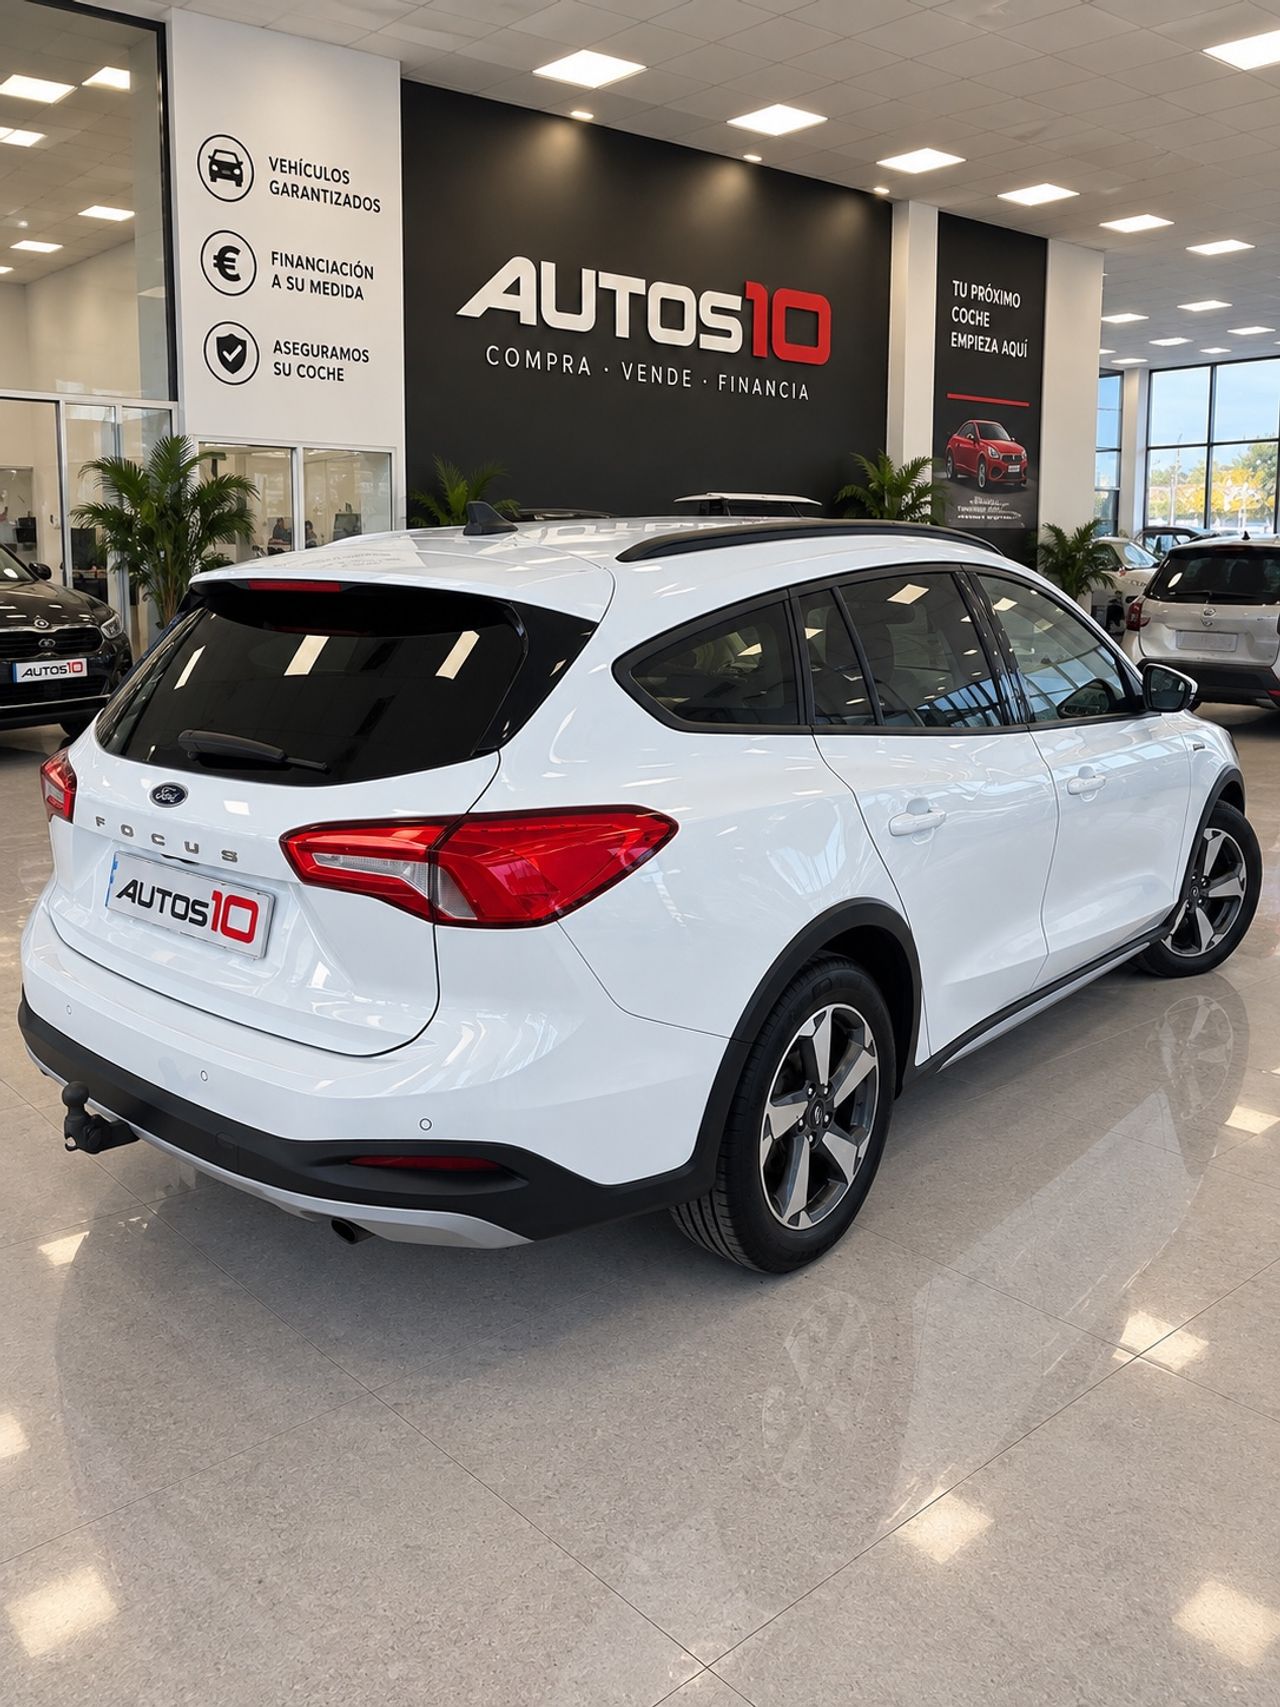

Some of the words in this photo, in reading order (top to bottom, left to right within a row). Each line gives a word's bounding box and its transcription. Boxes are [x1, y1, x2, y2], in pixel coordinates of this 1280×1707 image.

[268, 156, 350, 185] VEHÍCULOS
[269, 180, 381, 213] GARANTIZADOS
[271, 251, 374, 280] FINANCIACIÓN
[271, 274, 281, 289] A
[286, 276, 305, 292] SU
[309, 280, 364, 300] MEDIDA
[952, 280, 968, 298] TU
[970, 283, 1021, 308] PRÓXIMO
[456, 256, 831, 365] AUTOS10
[951, 306, 990, 327] COCHE
[273, 340, 369, 363] ASEGURAMOS
[951, 331, 998, 354] EMPIEZA
[1001, 339, 1028, 358] AQUÍ
[273, 362, 292, 377] SU
[296, 364, 344, 381] COCHE
[485, 345, 591, 376] COMPRA
[621, 362, 692, 388] VENDE
[718, 374, 809, 401] FINANCIA
[21, 661, 84, 678] AUTOS10
[95, 816, 238, 862] FOCUS
[116, 879, 259, 944] AUTOS10
